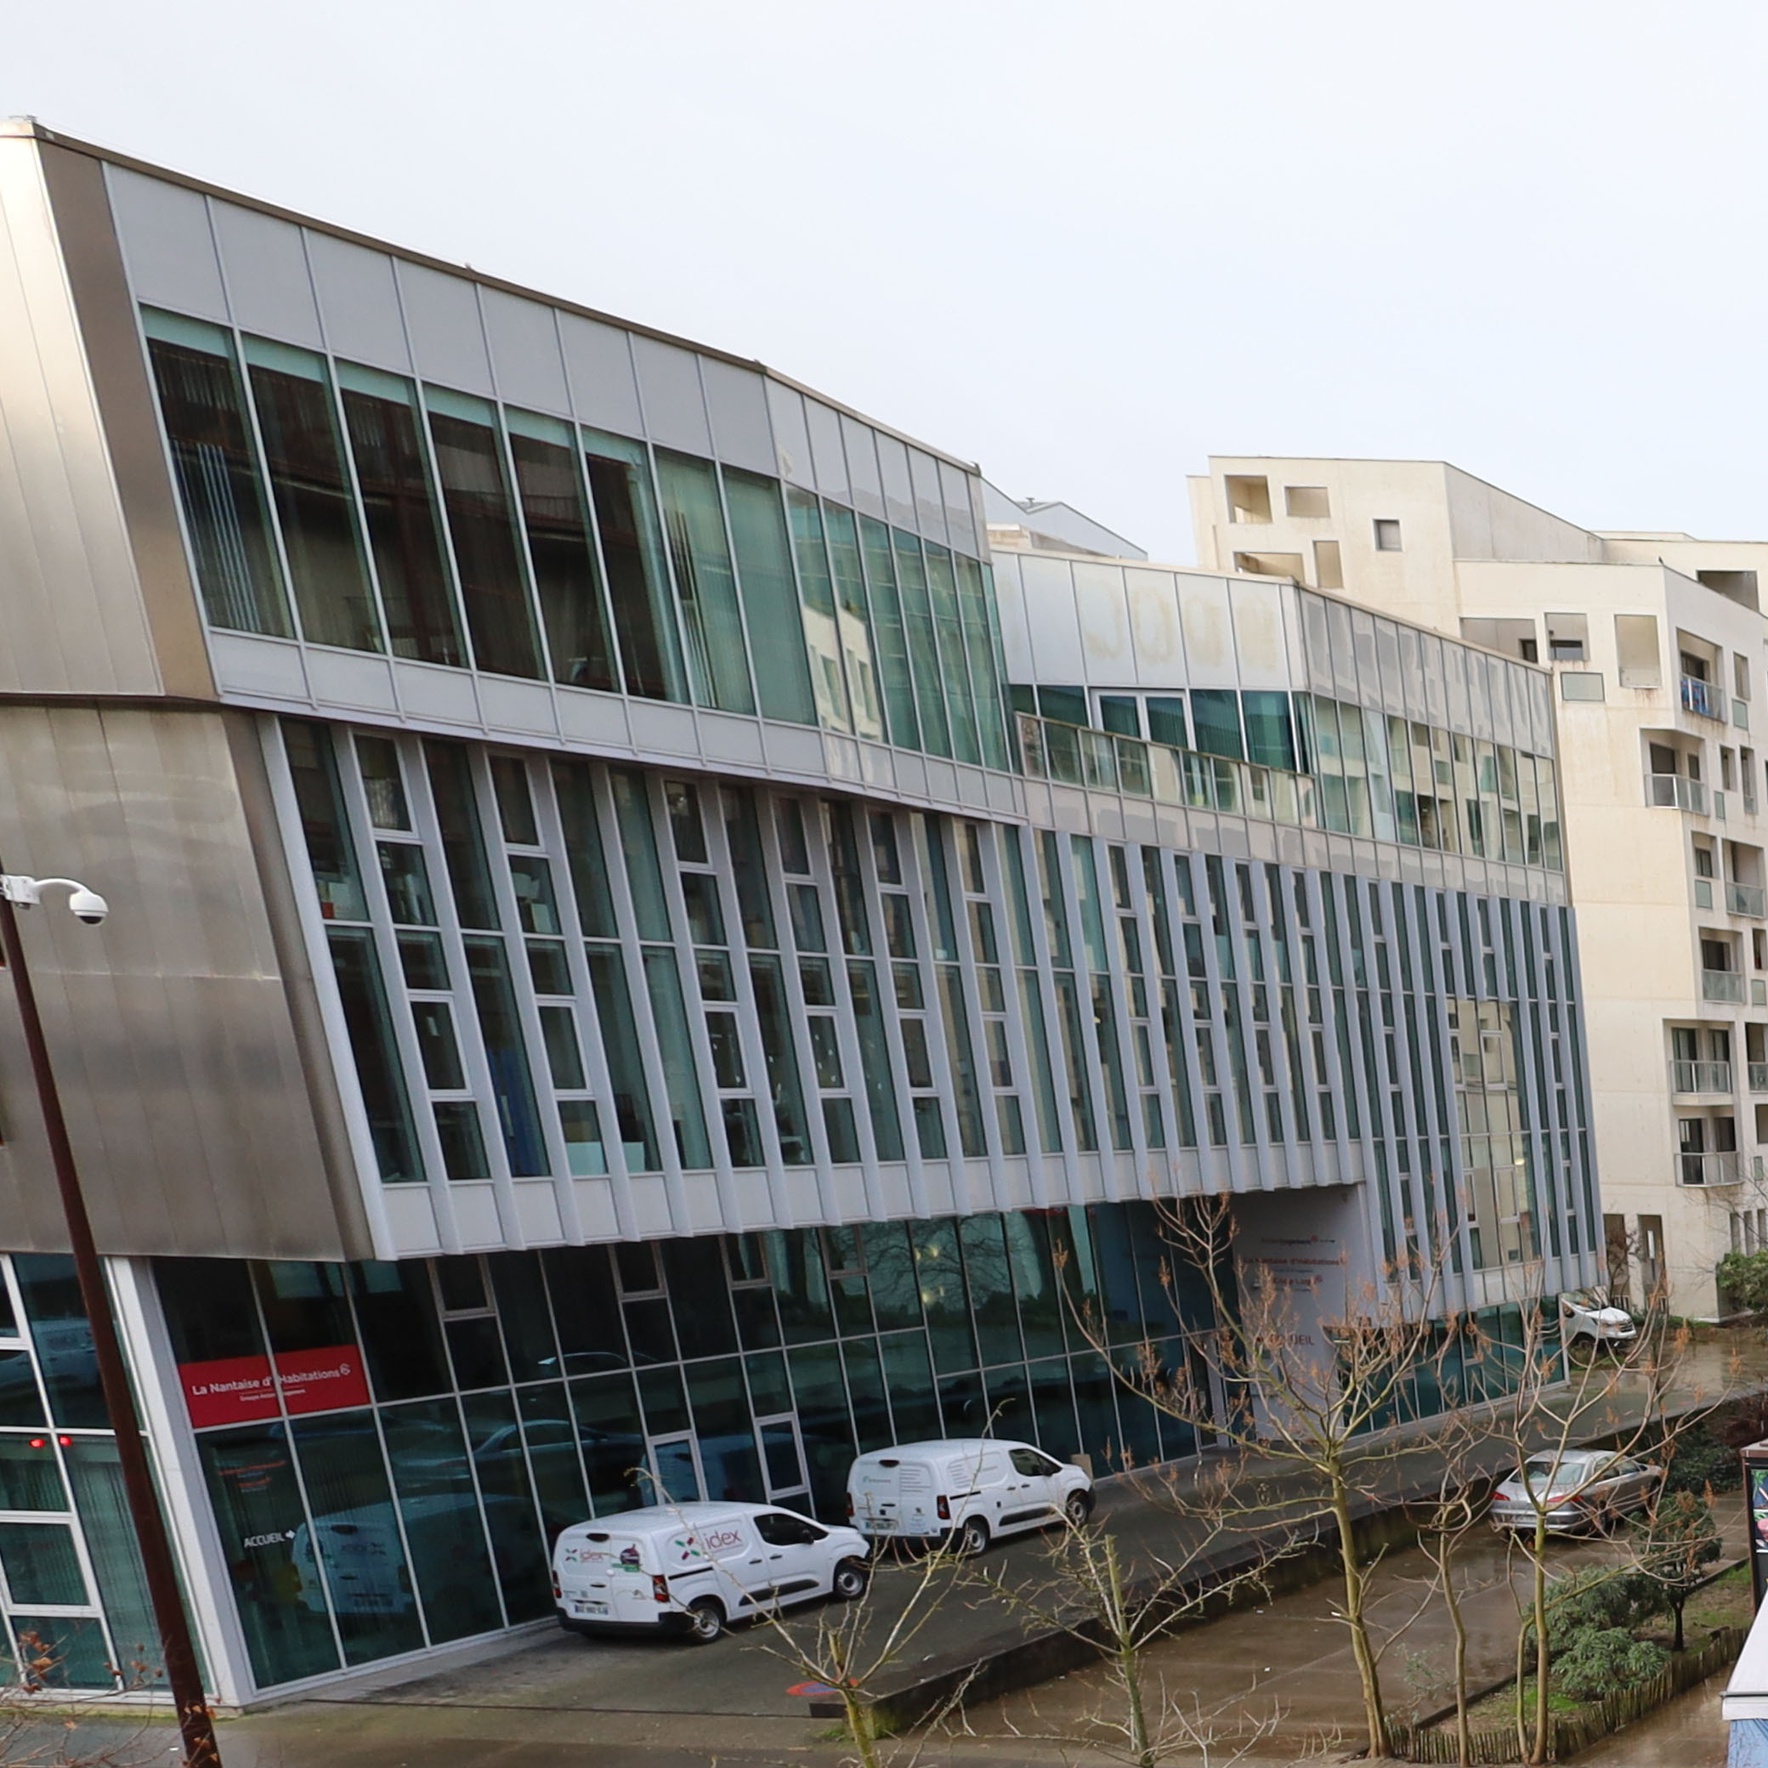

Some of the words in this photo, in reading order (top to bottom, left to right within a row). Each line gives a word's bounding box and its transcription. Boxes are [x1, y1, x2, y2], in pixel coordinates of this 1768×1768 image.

[192, 1385, 208, 1396] La
[209, 1378, 260, 1394] Nantaise
[243, 1531, 286, 1548] ACCUEIL
[705, 1529, 742, 1550] idex
